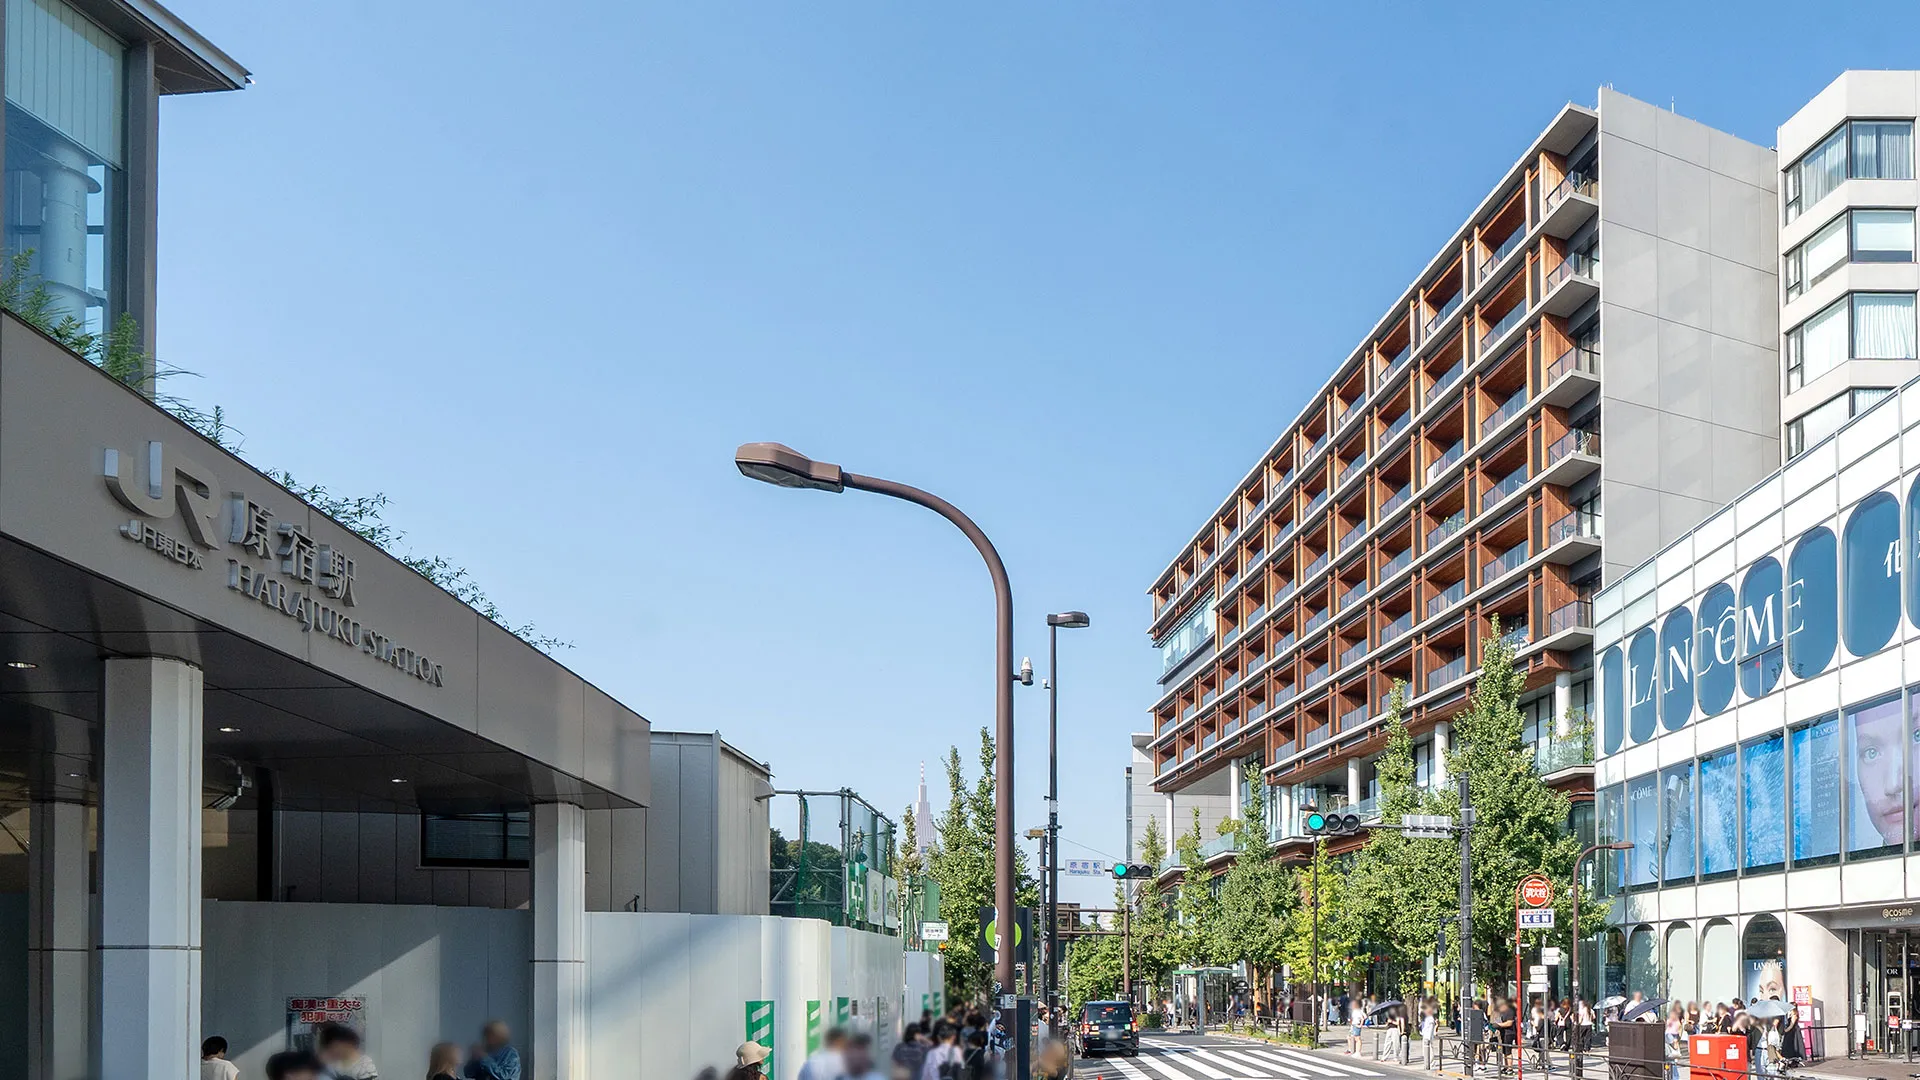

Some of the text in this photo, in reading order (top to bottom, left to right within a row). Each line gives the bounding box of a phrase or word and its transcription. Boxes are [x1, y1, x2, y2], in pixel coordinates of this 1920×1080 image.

[103, 440, 221, 551] JR
[119, 519, 204, 571] JR東日本
[228, 491, 358, 608] 原宿駅
[227, 557, 445, 689] HARAJUKU STATION
[1631, 578, 1805, 708] LANCÔME
[1620, 785, 1653, 805] LCÔME
[1069, 861, 1101, 870] 原宿駅
[1525, 887, 1547, 898] 消火栓
[1523, 915, 1550, 923] KEN
[1882, 907, 1914, 919] @cosme
